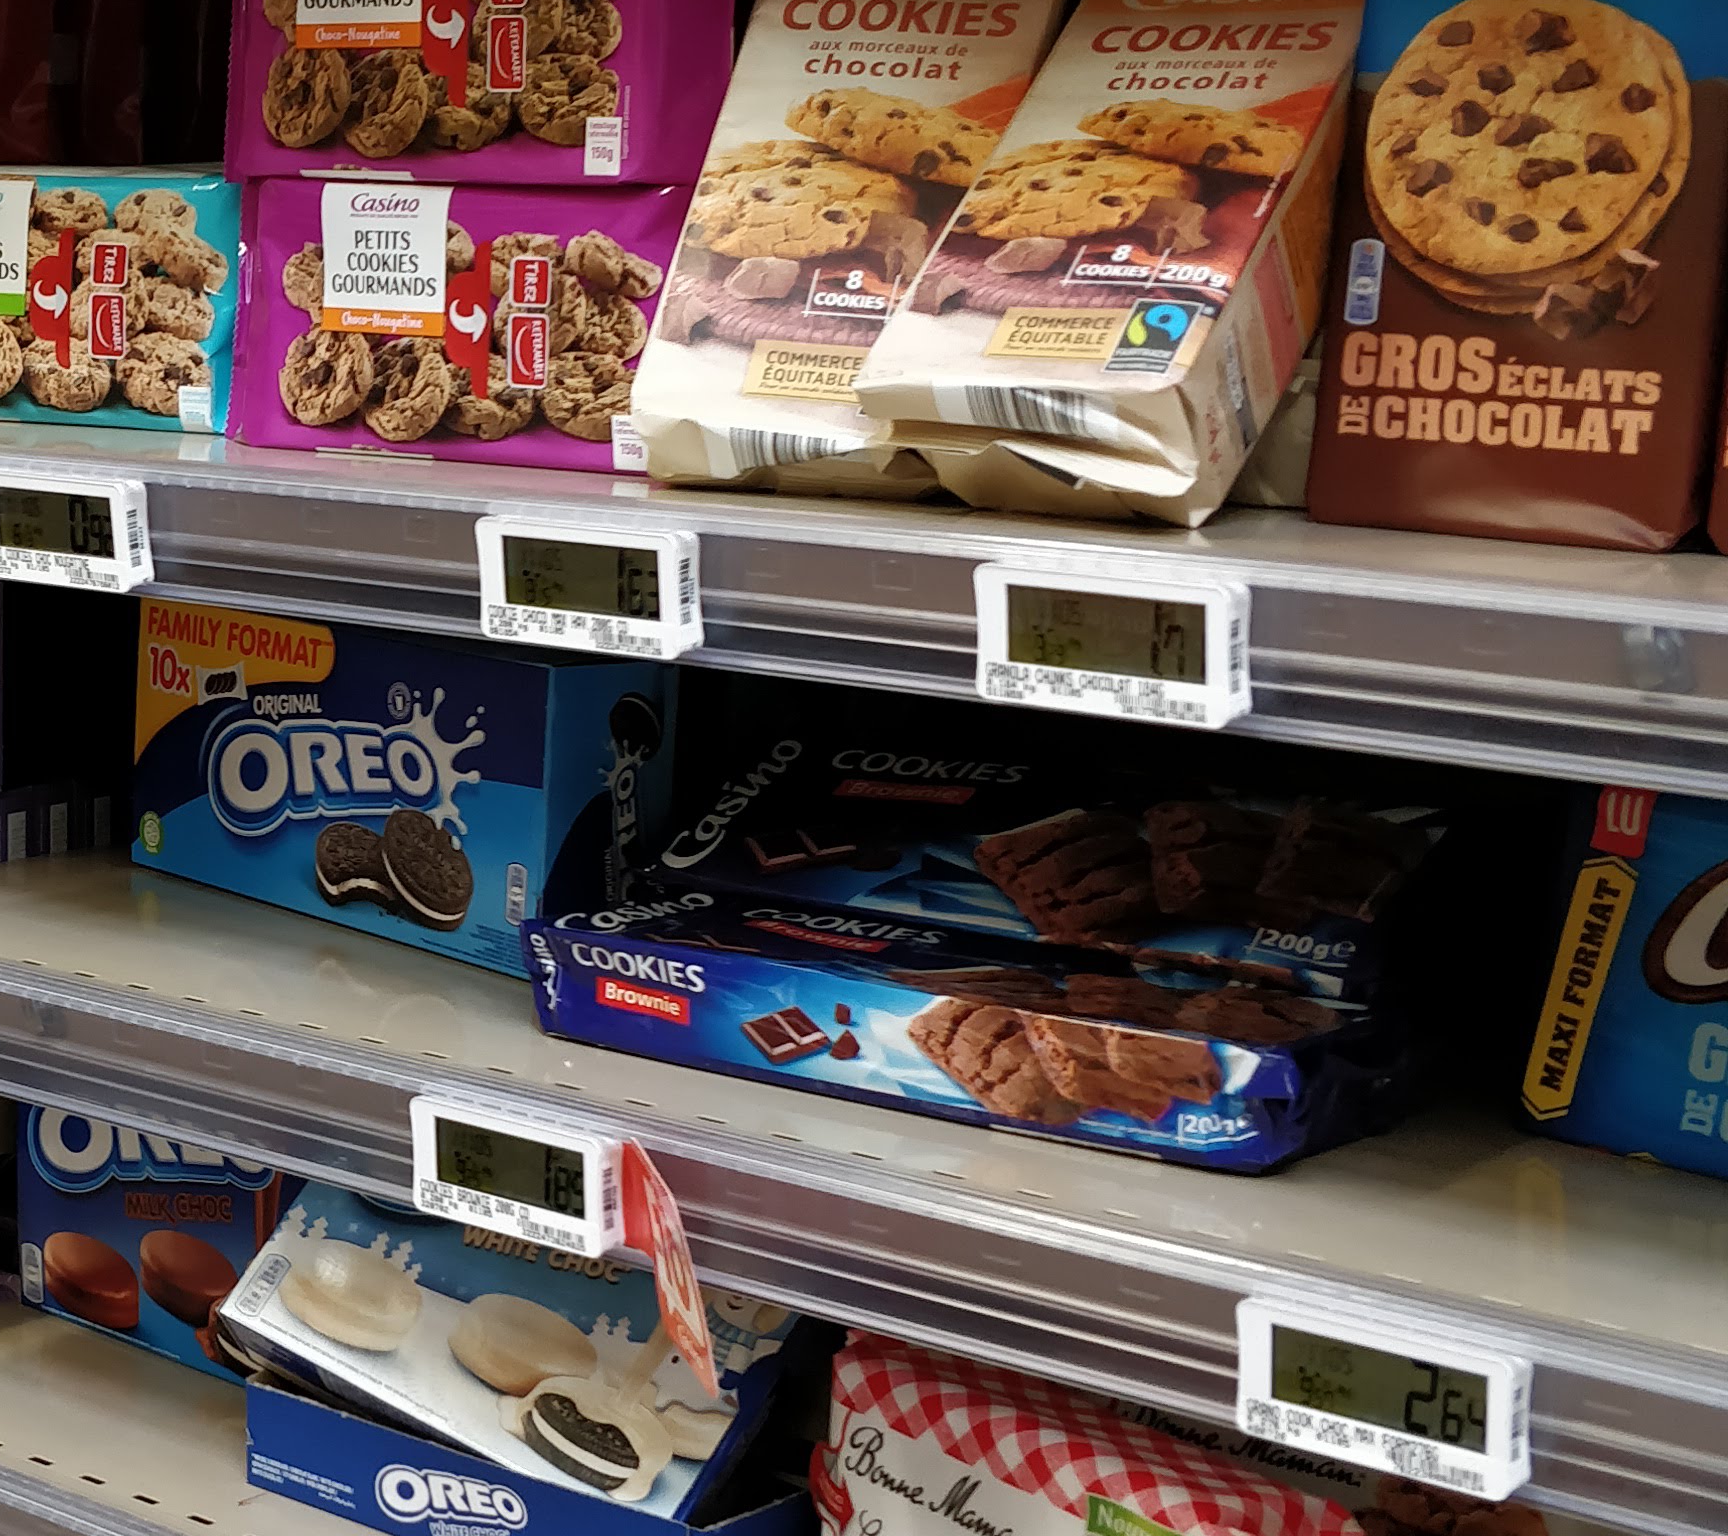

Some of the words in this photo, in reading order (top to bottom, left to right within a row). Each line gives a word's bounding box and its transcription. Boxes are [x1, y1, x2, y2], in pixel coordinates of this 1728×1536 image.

[315, 24, 401, 44] Choco-Nougatine
[809, 39, 841, 53] aux
[847, 40, 940, 57] morceaux
[944, 42, 970, 57] de
[803, 52, 964, 82] chocolat
[1106, 69, 1269, 92] chocolat
[590, 143, 614, 164] 150g
[844, 270, 865, 291] 8
[1075, 260, 1150, 282] COOKIES
[813, 291, 886, 312] COOKIES
[1013, 313, 1114, 332] COMMERCE
[1007, 325, 1109, 347] ÉQUITABLE
[765, 349, 863, 373] COMMERCE
[1340, 330, 1498, 394] GROS
[1497, 359, 1663, 406] ÉCLATS
[761, 364, 858, 389] ÉQUITABLE
[1337, 395, 1371, 437] DE
[1371, 392, 1656, 457] CHOCOLAT
[147, 606, 223, 651] FAMILY
[226, 614, 322, 669] FORMAT
[148, 647, 193, 697] 10x
[252, 693, 323, 717] ORIGINAL
[216, 728, 440, 816] OREO
[571, 940, 707, 994] COOKIES
[1538, 1013, 1578, 1094] MAXI
[1562, 876, 1622, 1010] FORMAT
[603, 981, 683, 1018] Brownie
[126, 1192, 175, 1221] MILK
[175, 1193, 233, 1223] CHOC
[379, 1465, 525, 1526] OREO
